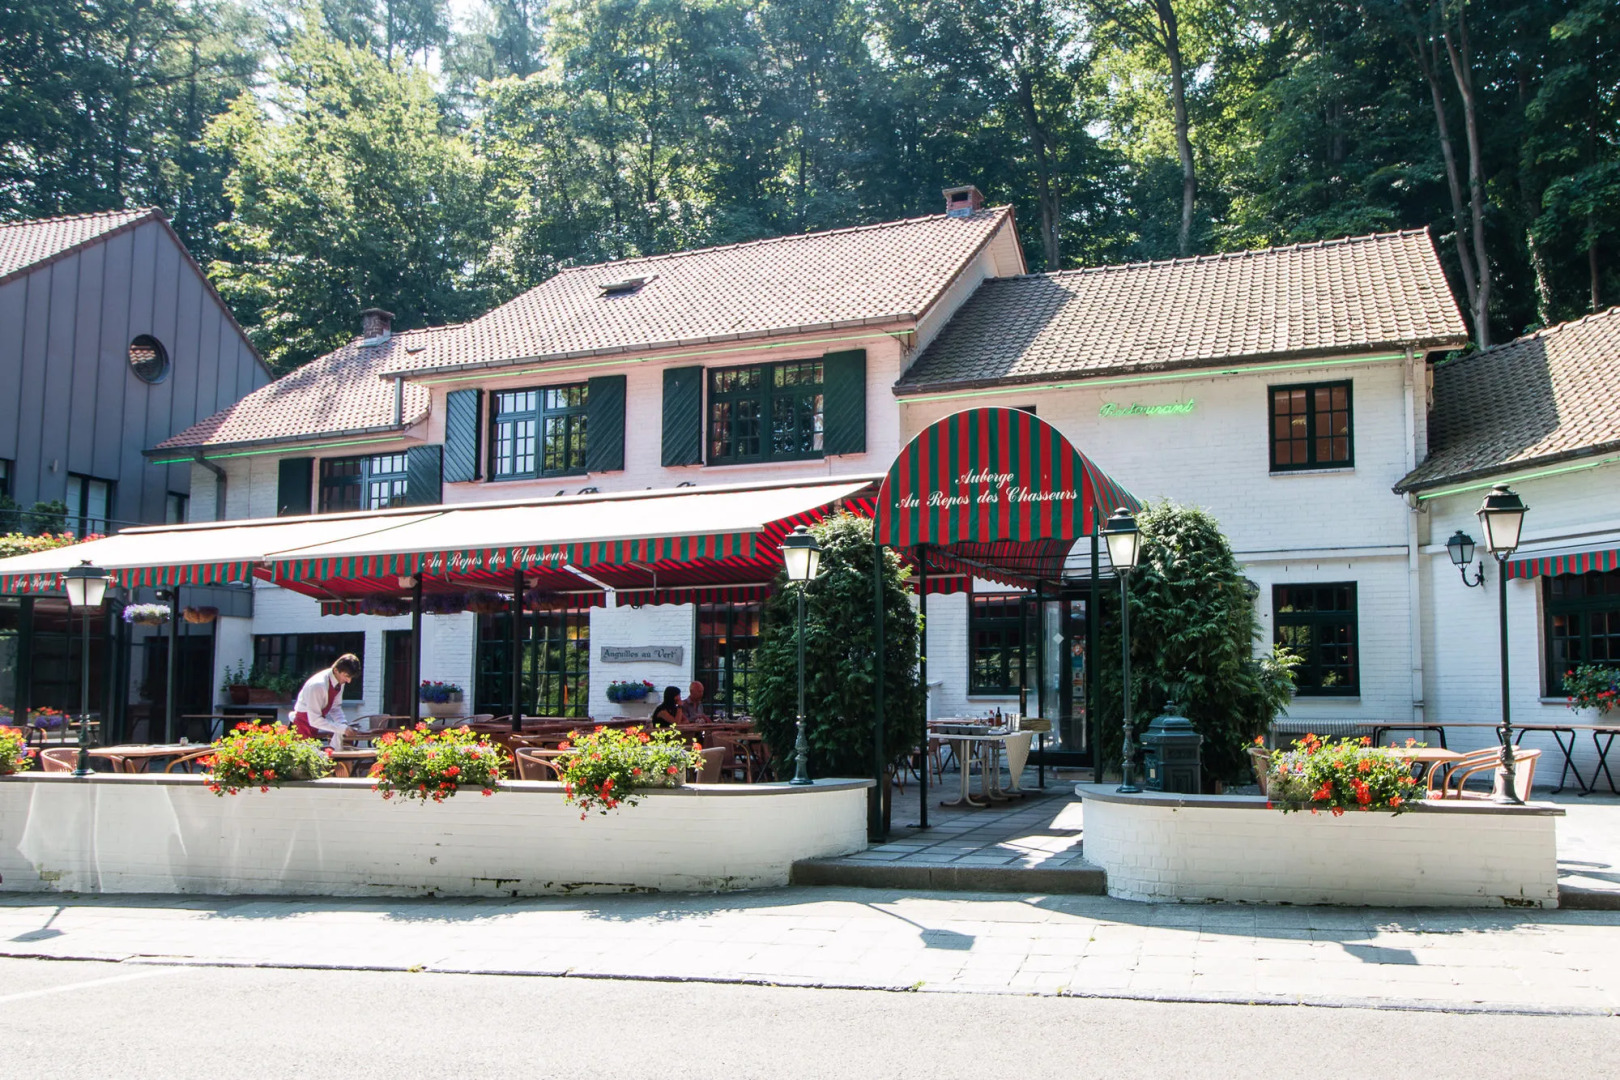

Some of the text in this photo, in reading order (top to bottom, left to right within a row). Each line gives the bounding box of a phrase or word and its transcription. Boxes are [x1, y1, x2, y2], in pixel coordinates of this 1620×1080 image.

[1098, 398, 1195, 418] Restaurant
[955, 467, 1014, 489] Auberge
[895, 486, 1078, 510] Au Repos des Chasseurs
[421, 547, 569, 570] Au Repos des Chasseurs
